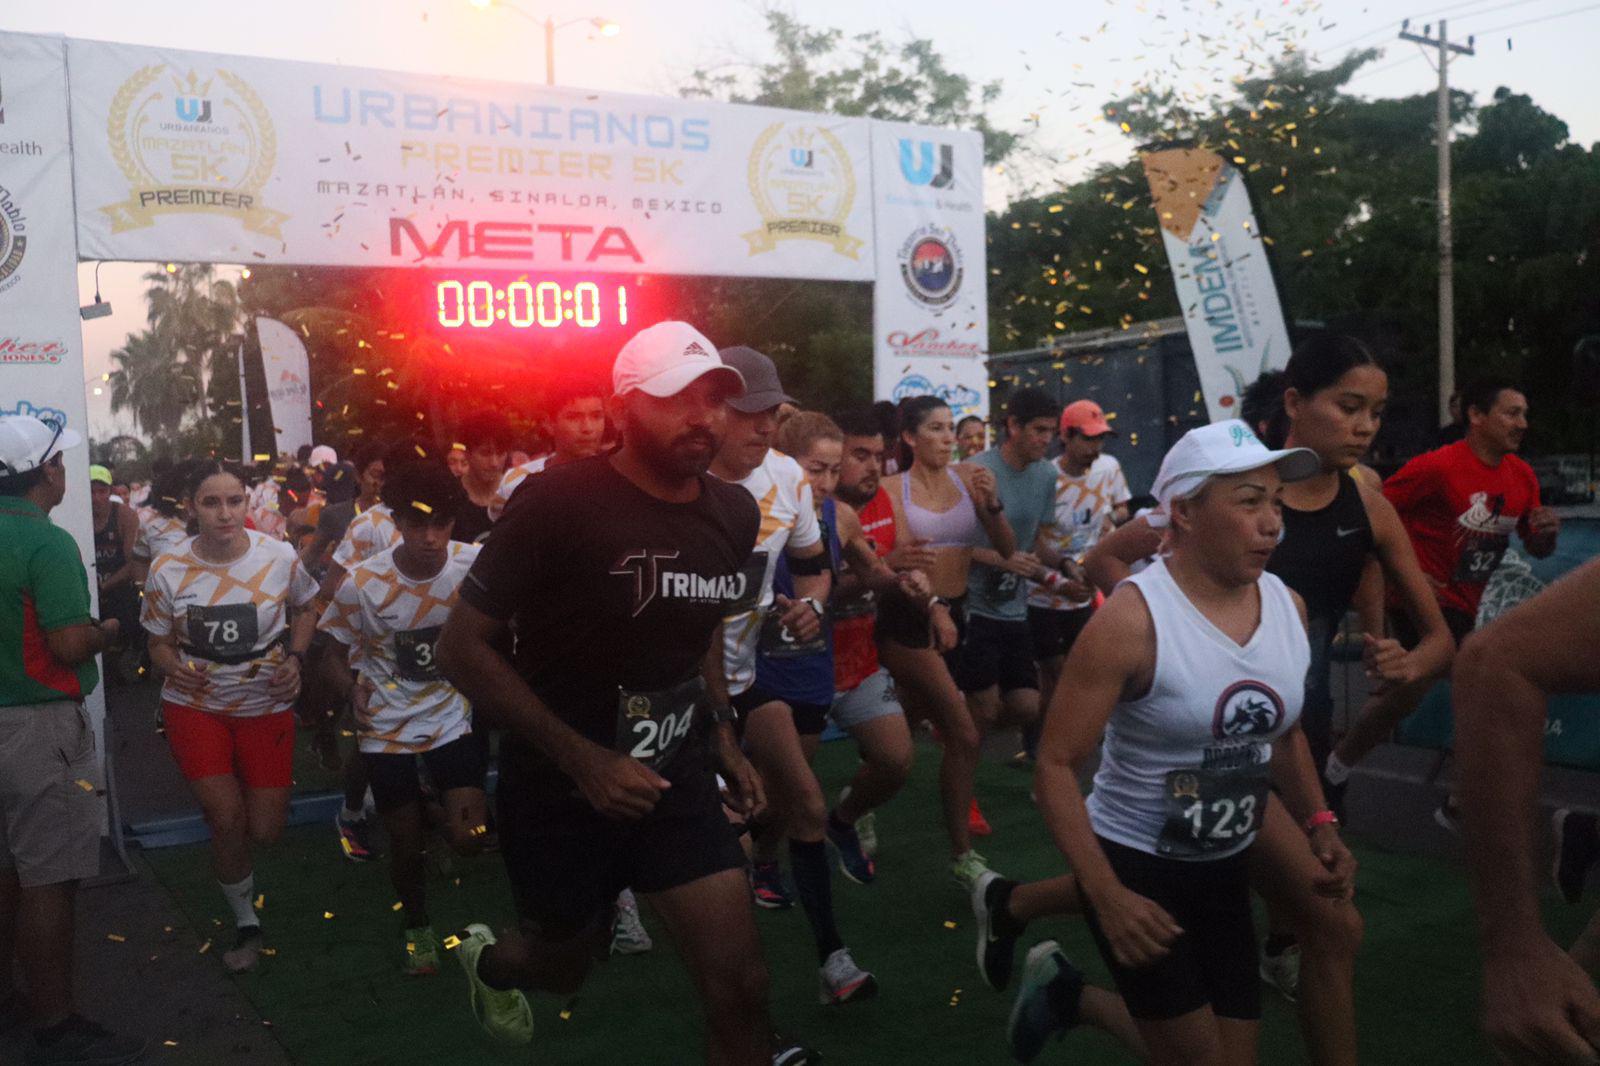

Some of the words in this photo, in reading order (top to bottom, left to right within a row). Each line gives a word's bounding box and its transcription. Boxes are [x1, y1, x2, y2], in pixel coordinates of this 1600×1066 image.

[313, 85, 710, 152] URBANIANOS
[171, 153, 230, 182] 5K
[402, 141, 612, 181] PREMIER
[632, 157, 685, 187] 5K
[139, 188, 254, 209] PREMIER
[389, 217, 645, 263] META
[767, 220, 841, 238] PREMIER
[437, 280, 628, 328] 00:00:01
[1470, 551, 1496, 572] 32
[204, 620, 239, 644] 78
[630, 703, 695, 758] 204
[1184, 794, 1256, 839] 123
